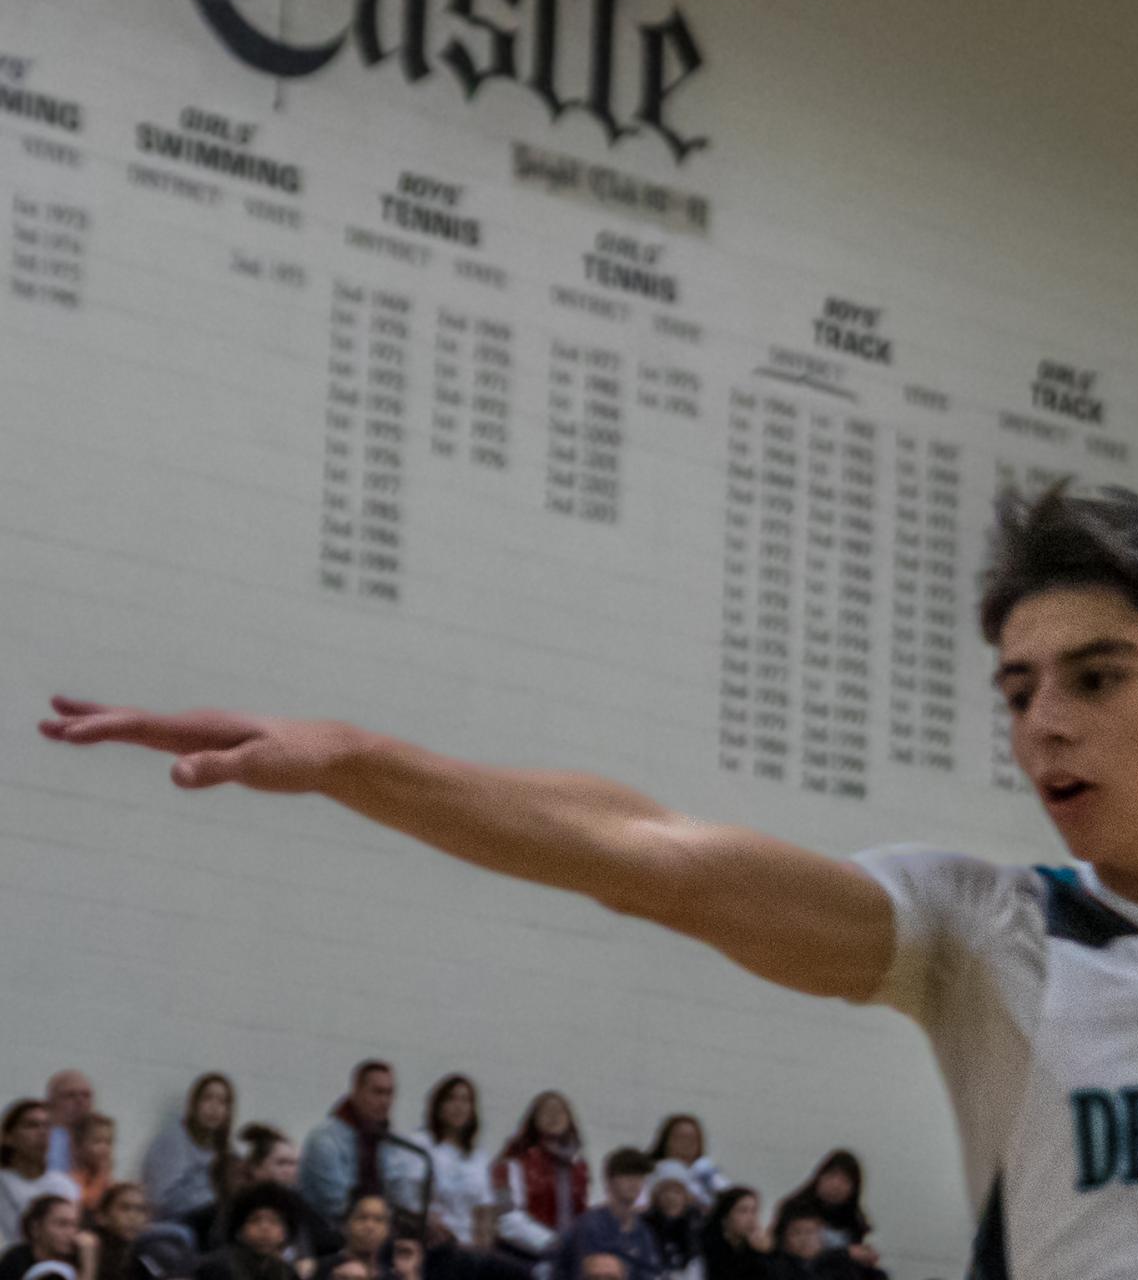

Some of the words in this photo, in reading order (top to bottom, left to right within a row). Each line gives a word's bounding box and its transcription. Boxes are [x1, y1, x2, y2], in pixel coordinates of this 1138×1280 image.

[136, 122, 300, 193] SWIMMING
[379, 194, 481, 247] TENNIS
[583, 252, 678, 304] TENNIS
[813, 320, 893, 365] TRACK
[1030, 381, 1103, 426] TRACK
